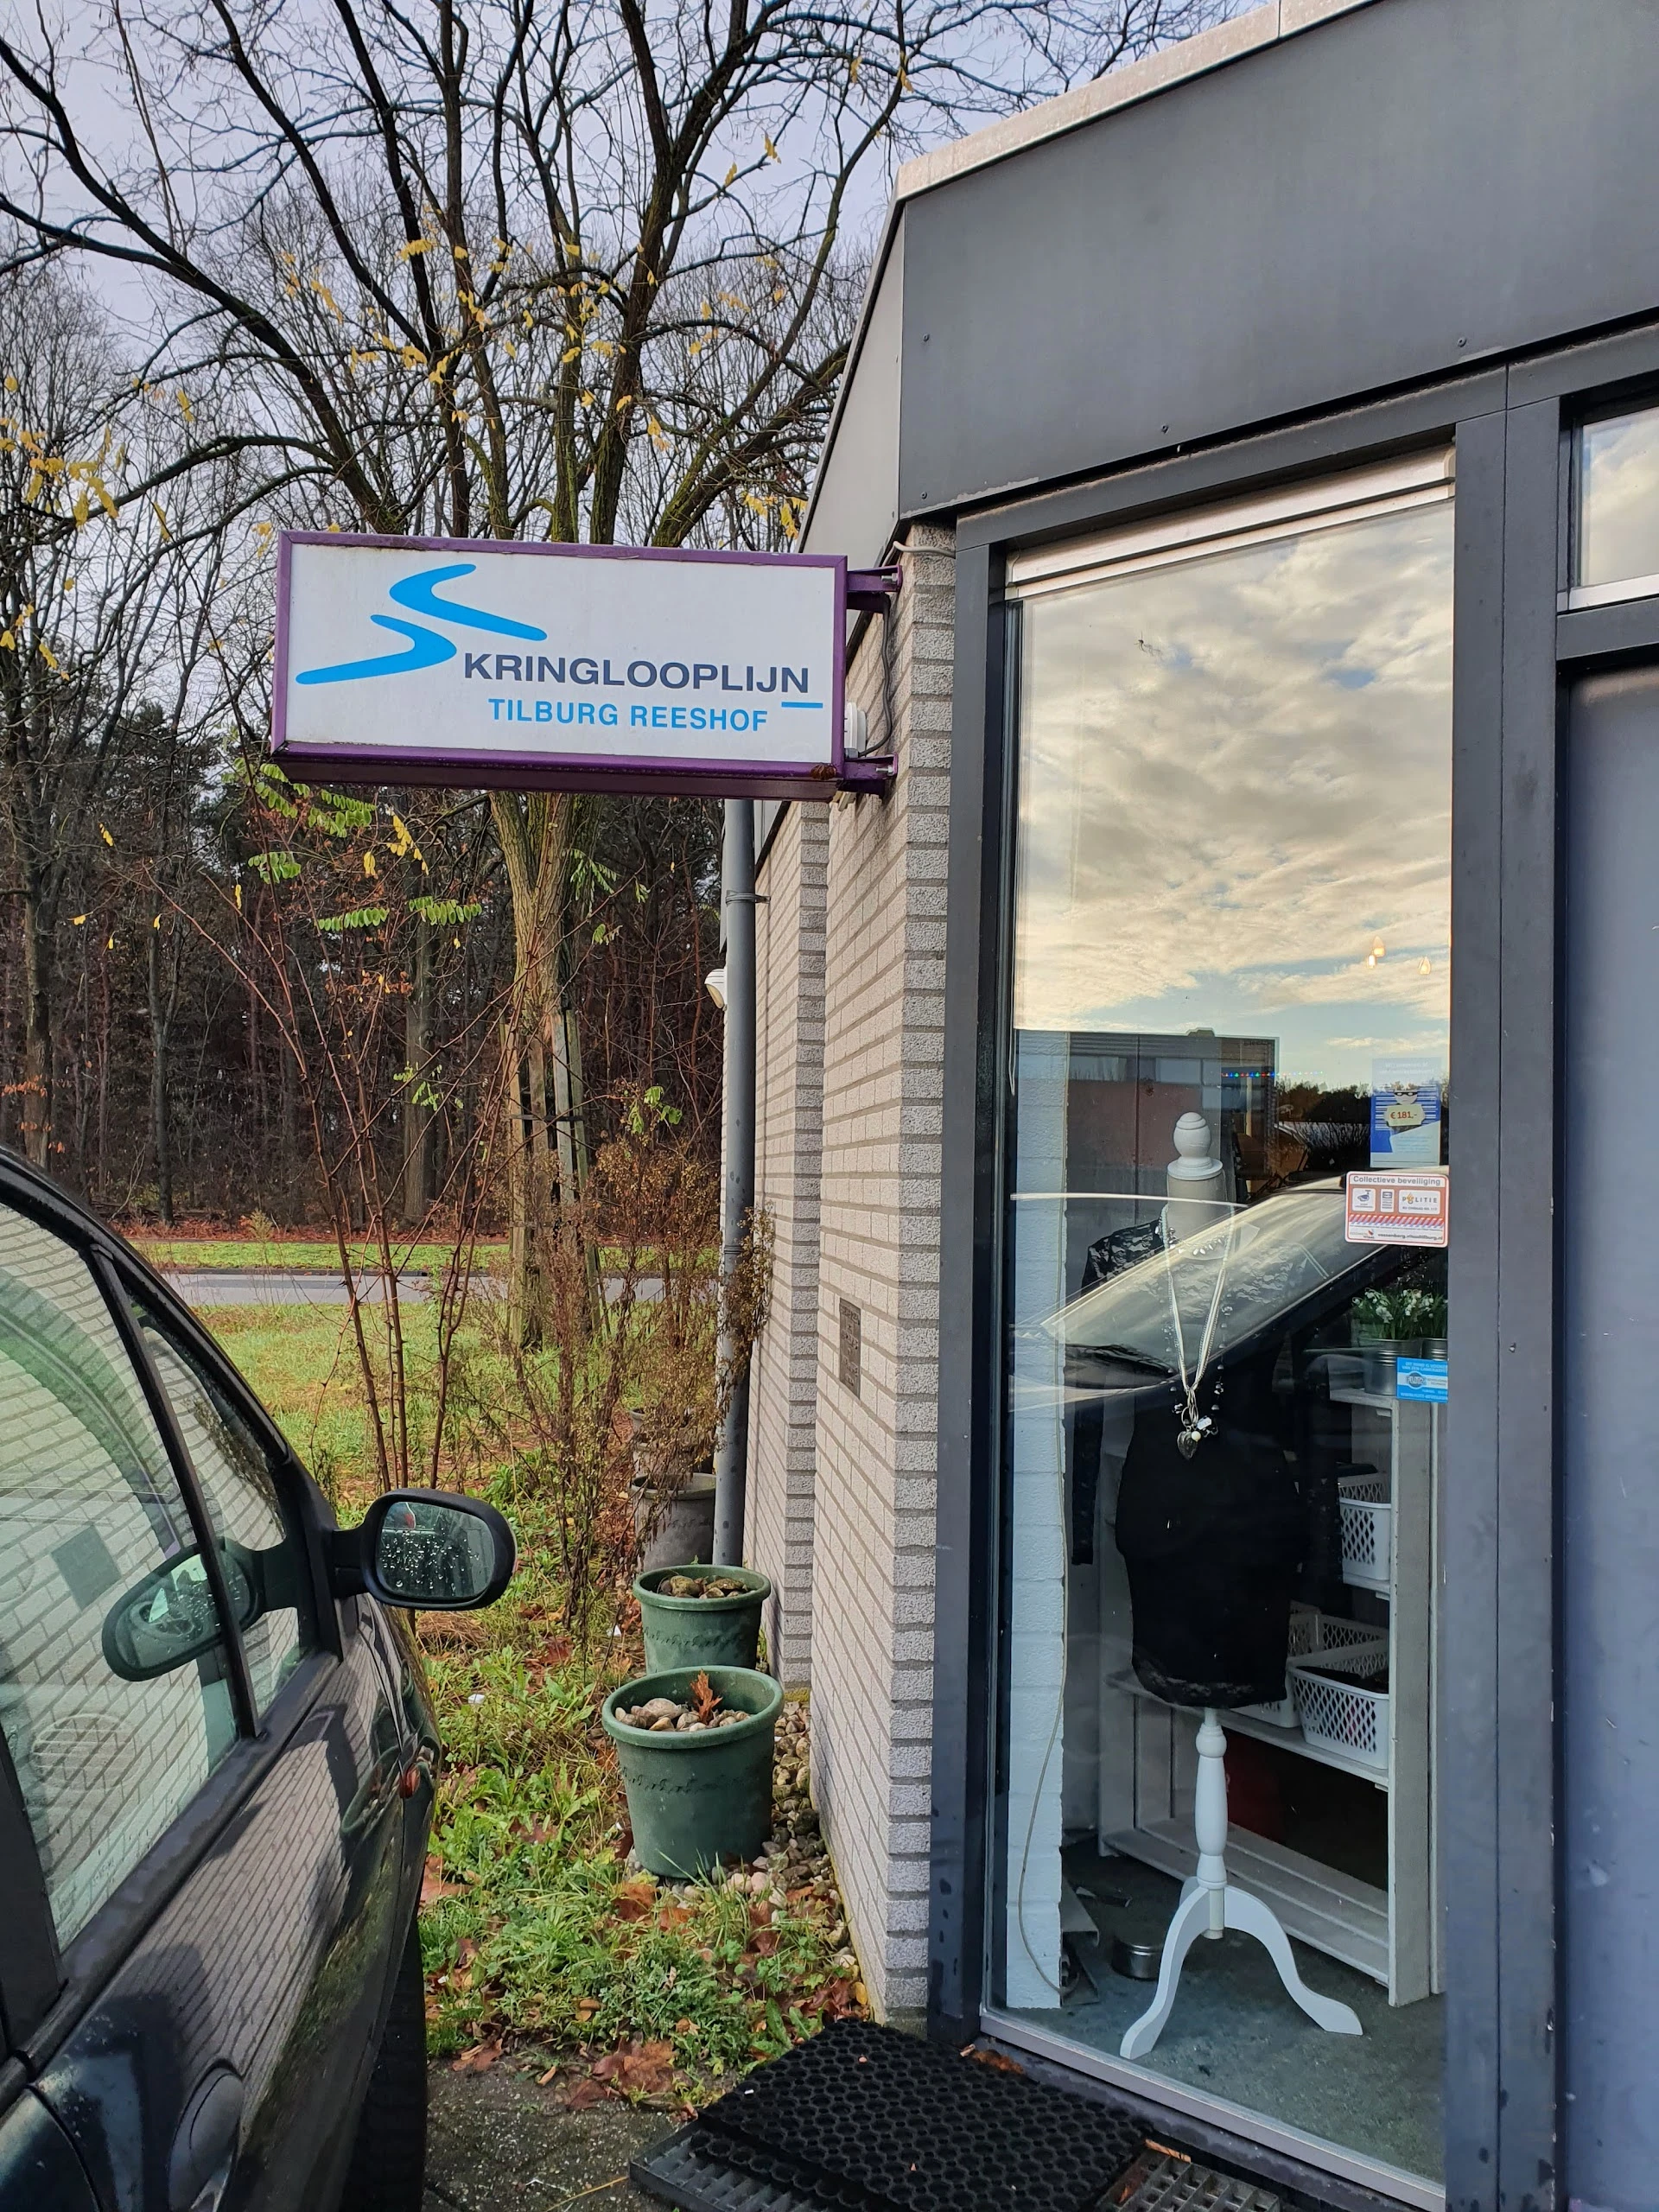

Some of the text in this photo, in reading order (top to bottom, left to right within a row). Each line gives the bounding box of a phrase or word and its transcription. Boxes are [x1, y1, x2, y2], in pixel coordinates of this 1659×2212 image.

[463, 652, 810, 694] KRINGLOOPLIJN
[488, 698, 768, 732] TILBURG REESHOF
[1353, 1175, 1441, 1186] Collectieve beveiliging
[1402, 1196, 1438, 1205] POLITIE
